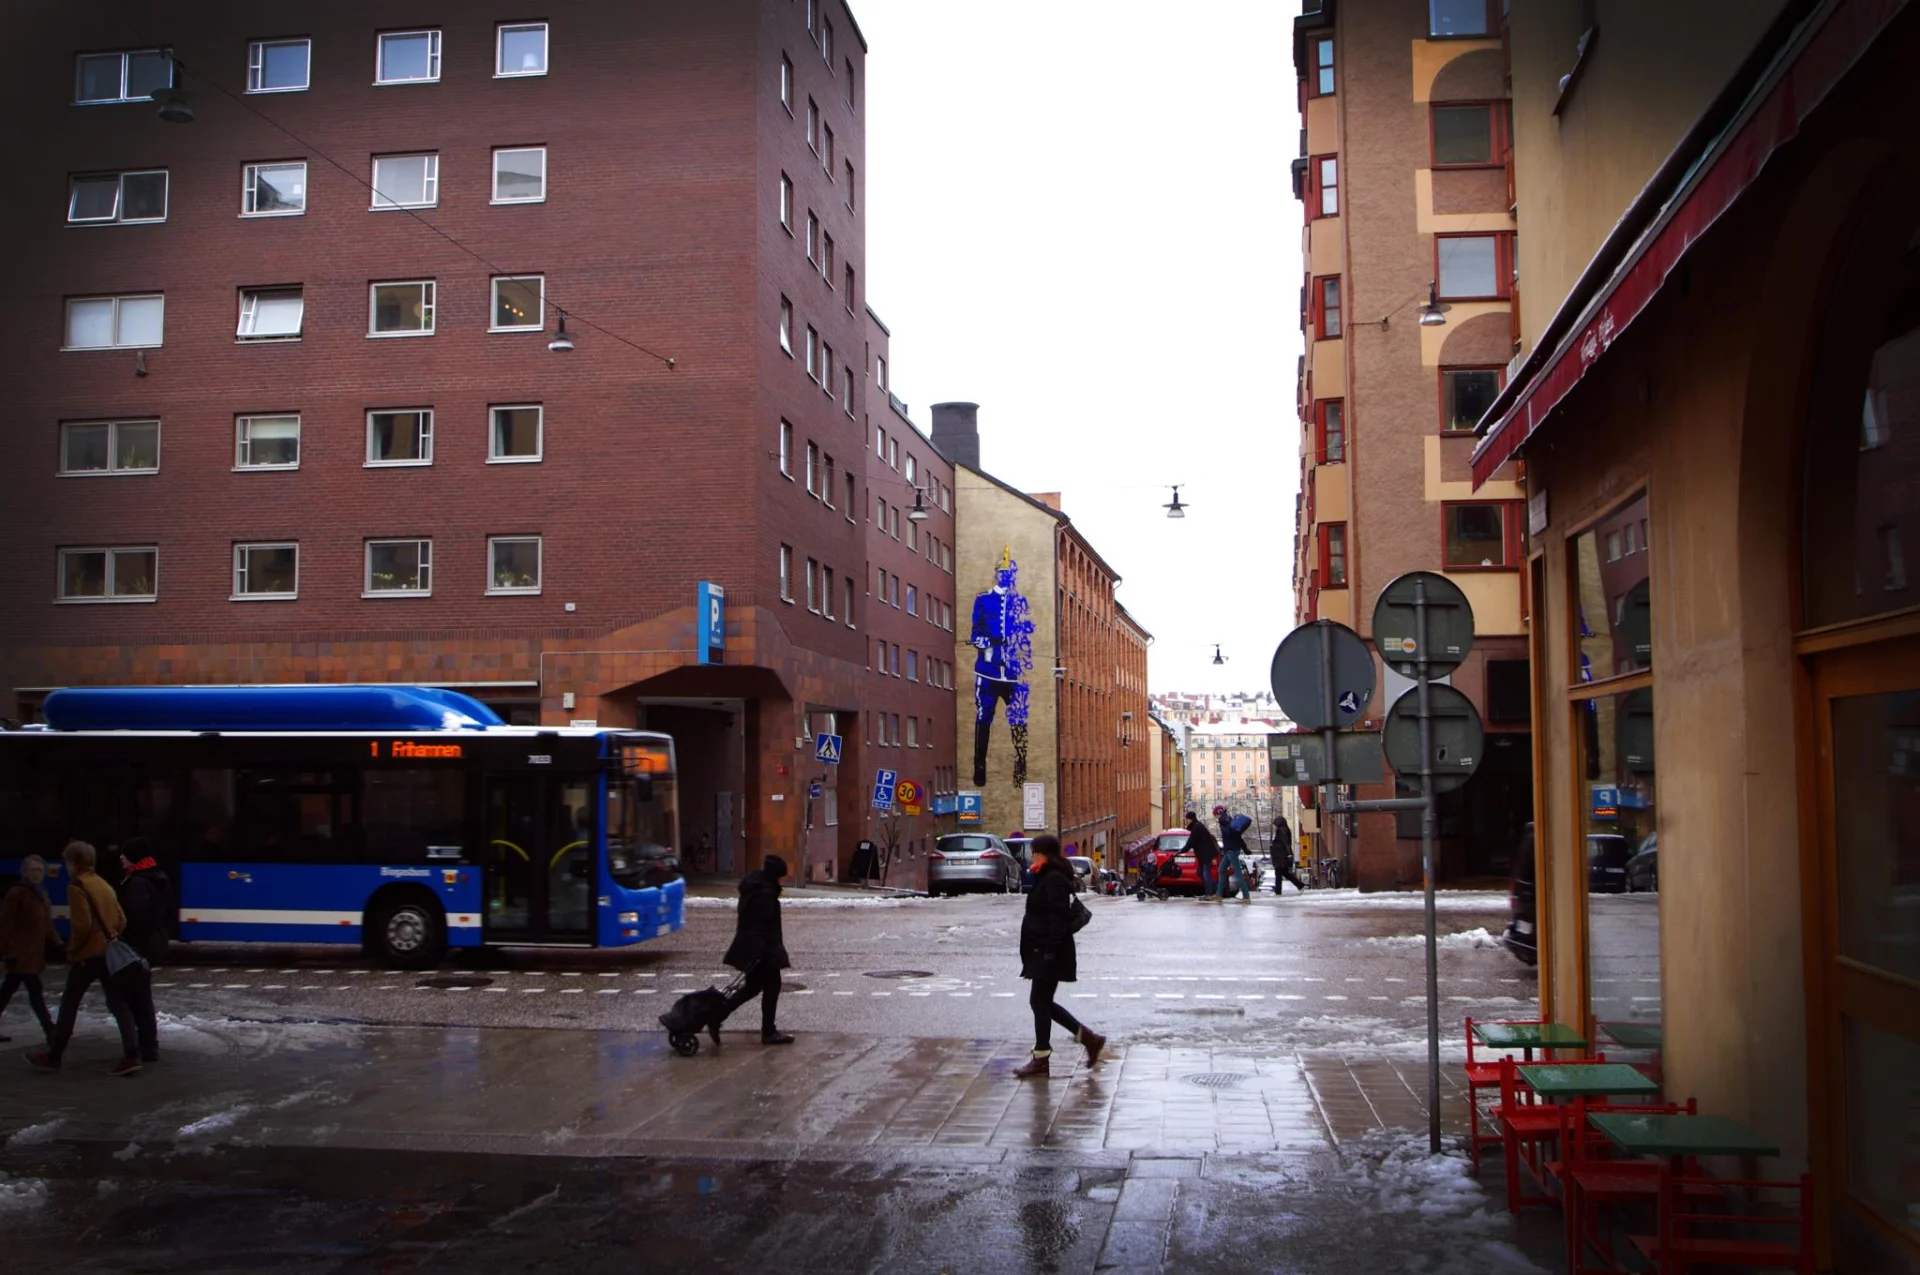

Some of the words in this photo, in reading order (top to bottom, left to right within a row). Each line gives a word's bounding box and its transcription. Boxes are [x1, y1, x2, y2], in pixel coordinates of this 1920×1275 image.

[711, 598, 720, 632] P
[370, 740, 379, 758] 1
[881, 773, 892, 784] P
[899, 784, 914, 800] 30
[964, 797, 975, 810] P
